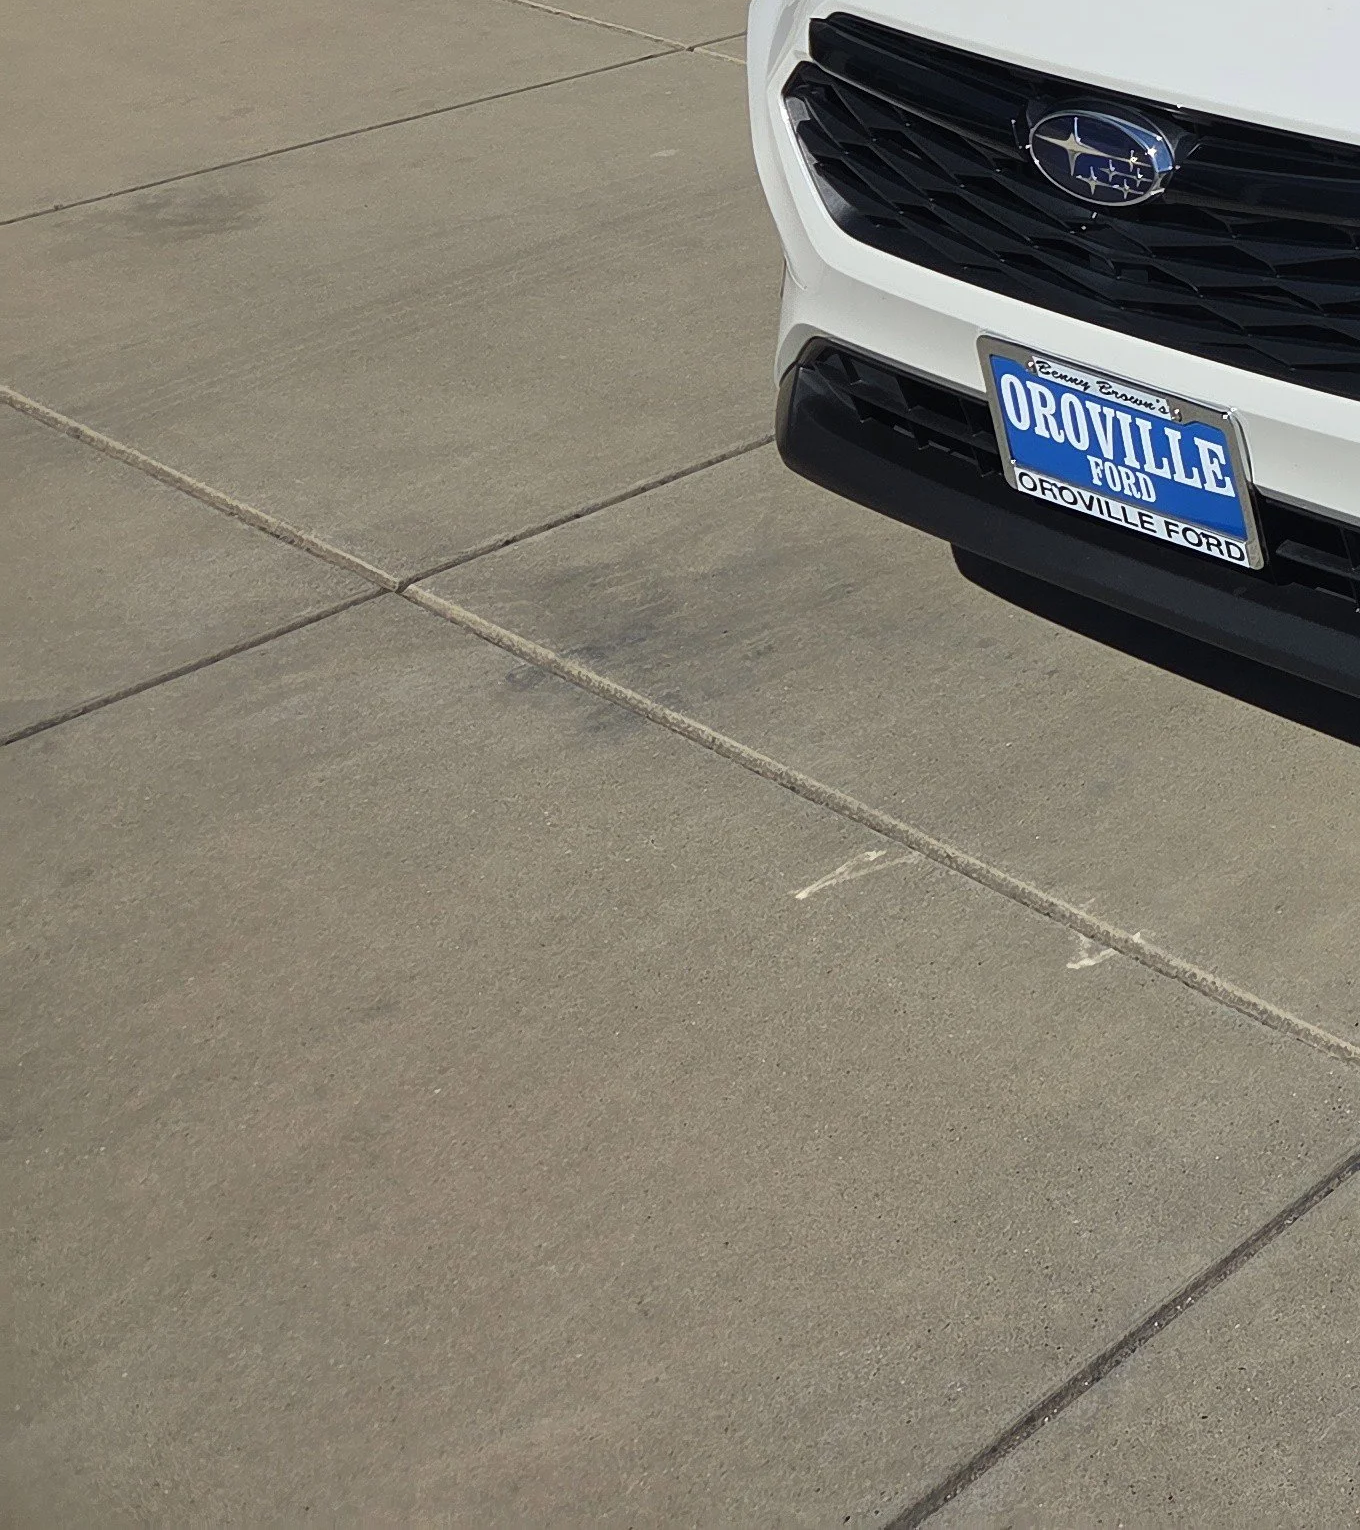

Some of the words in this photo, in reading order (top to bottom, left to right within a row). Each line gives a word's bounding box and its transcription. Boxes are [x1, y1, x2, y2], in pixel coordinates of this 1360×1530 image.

[1035, 359, 1091, 392] Benny
[1095, 379, 1171, 415] Brown's
[1000, 373, 1236, 498] OROVILLE
[1086, 454, 1157, 503] FORD
[1018, 470, 1157, 534] OROVILLE
[1163, 519, 1246, 562] FORD
